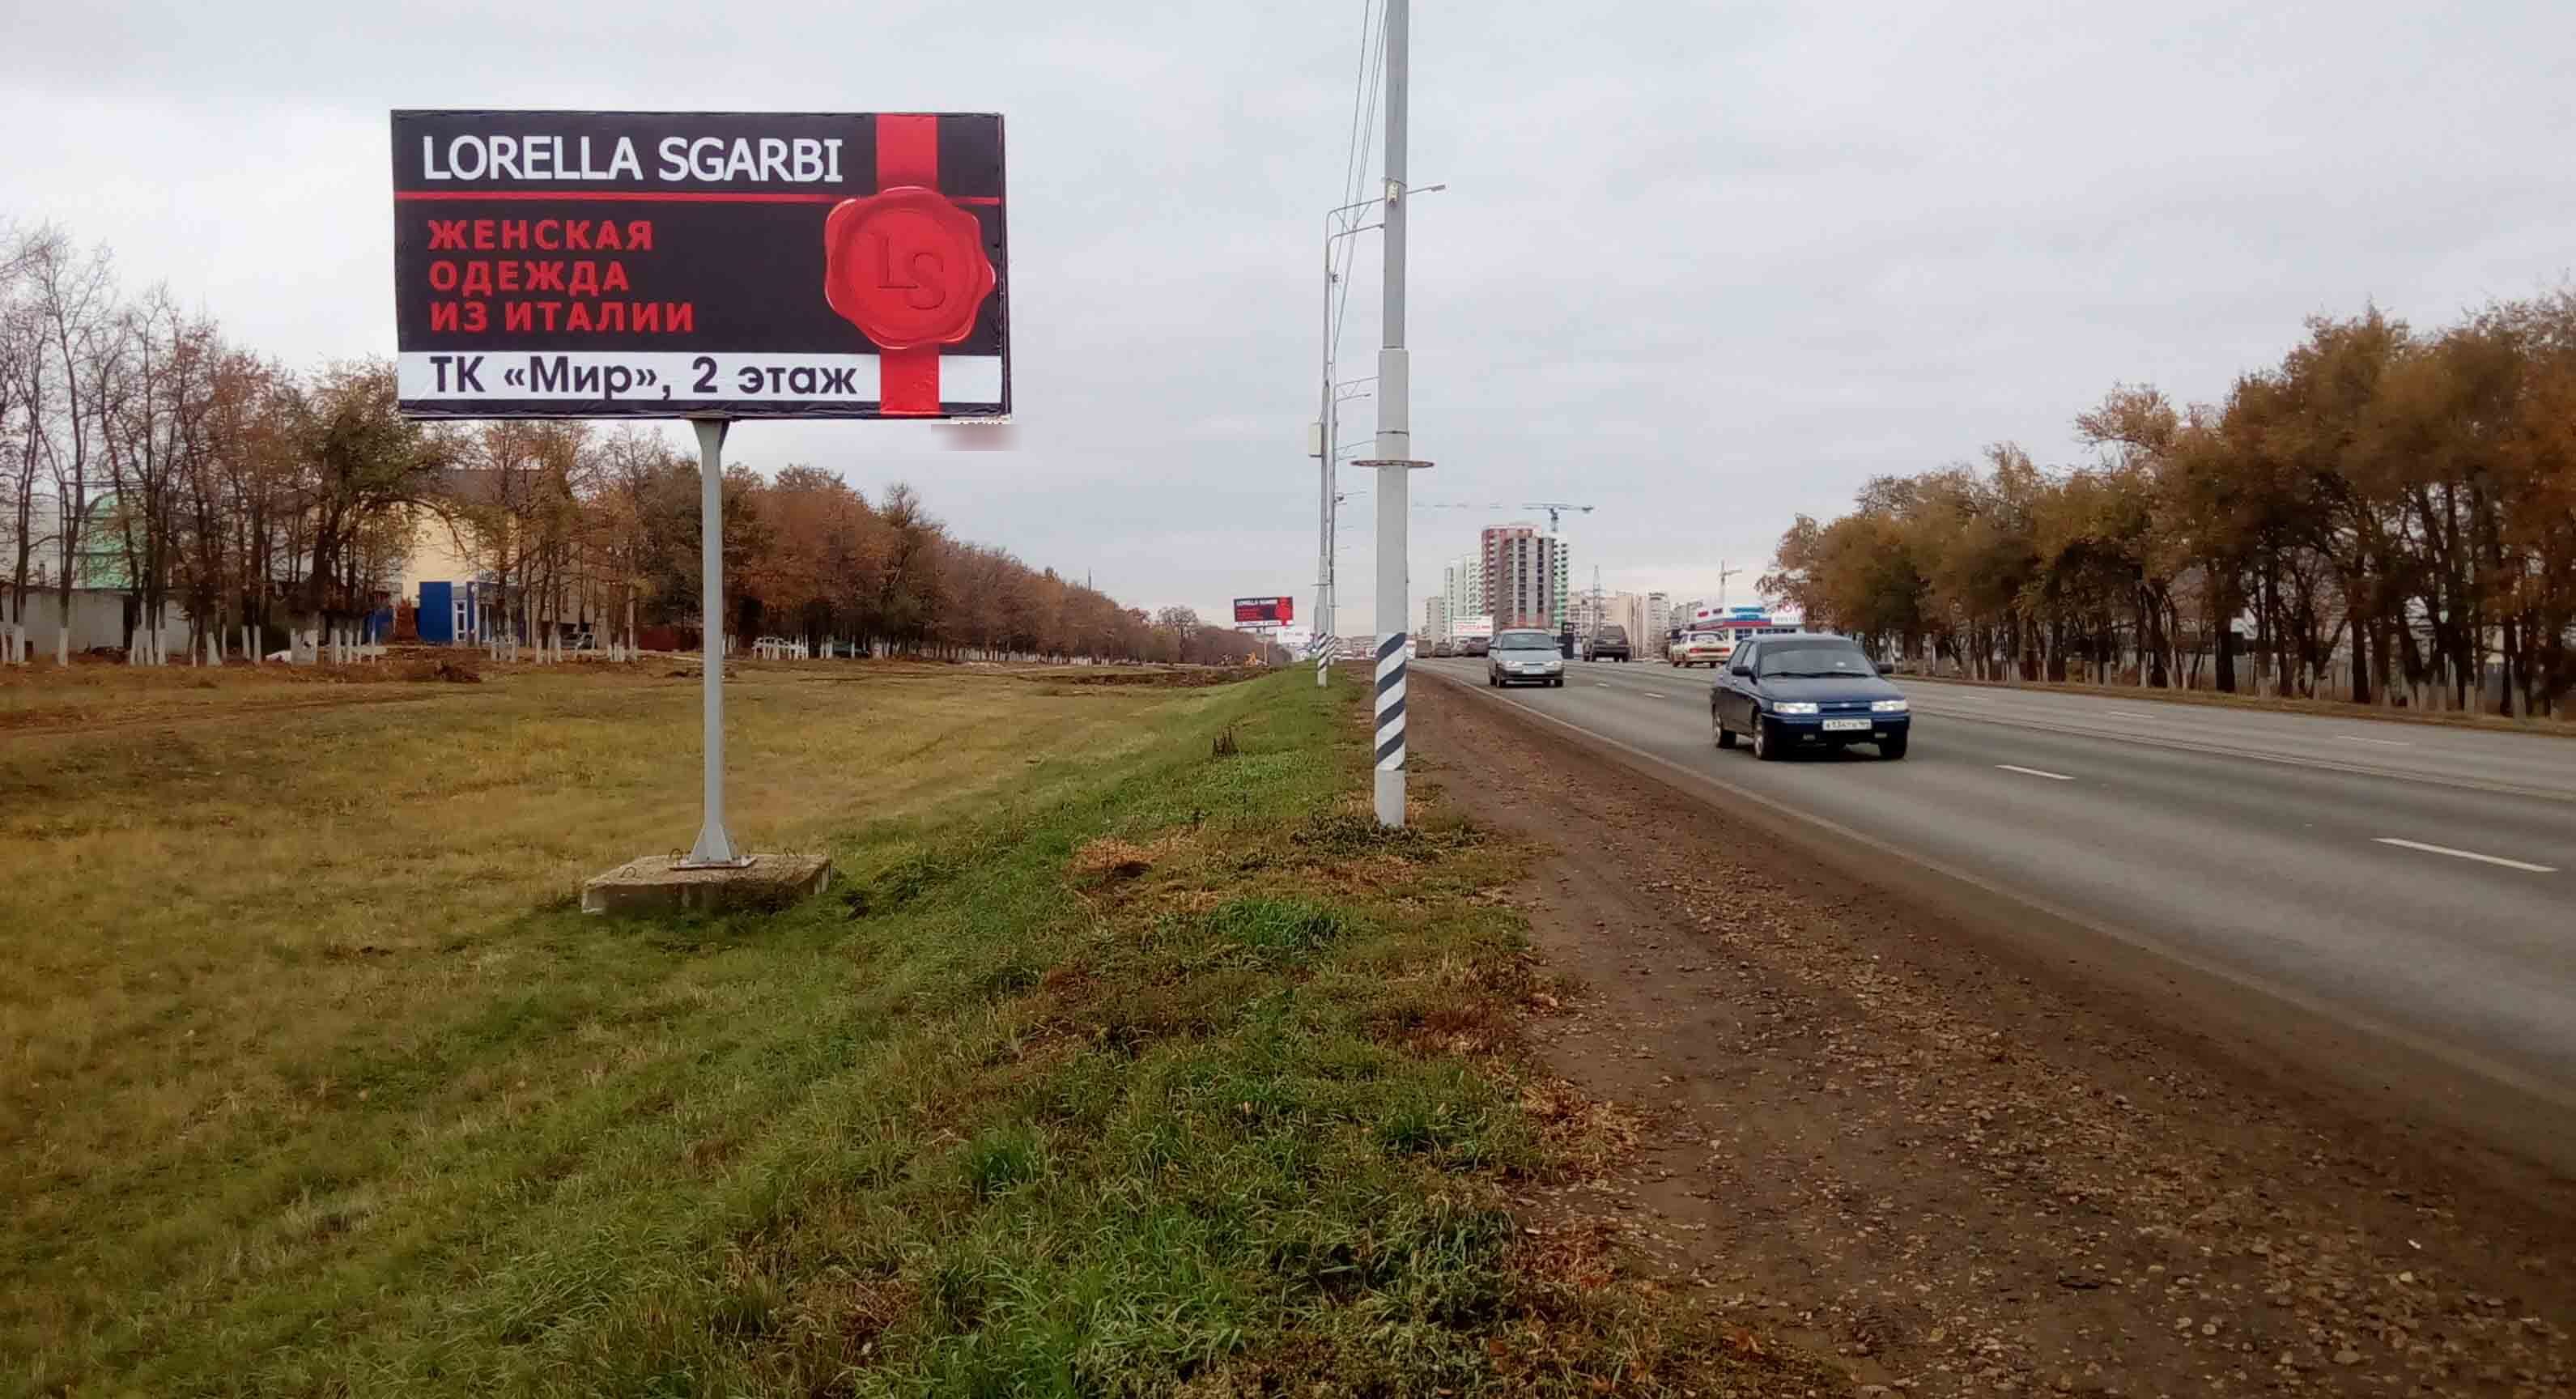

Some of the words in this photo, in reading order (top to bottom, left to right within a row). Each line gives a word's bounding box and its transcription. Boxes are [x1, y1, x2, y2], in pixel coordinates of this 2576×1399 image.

[423, 135, 644, 181] LORELLA
[658, 138, 843, 182] SGARBI
[427, 219, 654, 250] ЖЕНСКАЯ
[428, 260, 630, 296] ОДЕЖДА
[431, 302, 487, 333] ИЗ
[505, 301, 694, 333] ИТАЛИИ
[430, 356, 486, 393] ТК
[504, 356, 673, 401] «Мир»,
[692, 356, 719, 393] 2
[738, 363, 858, 396] этаж
